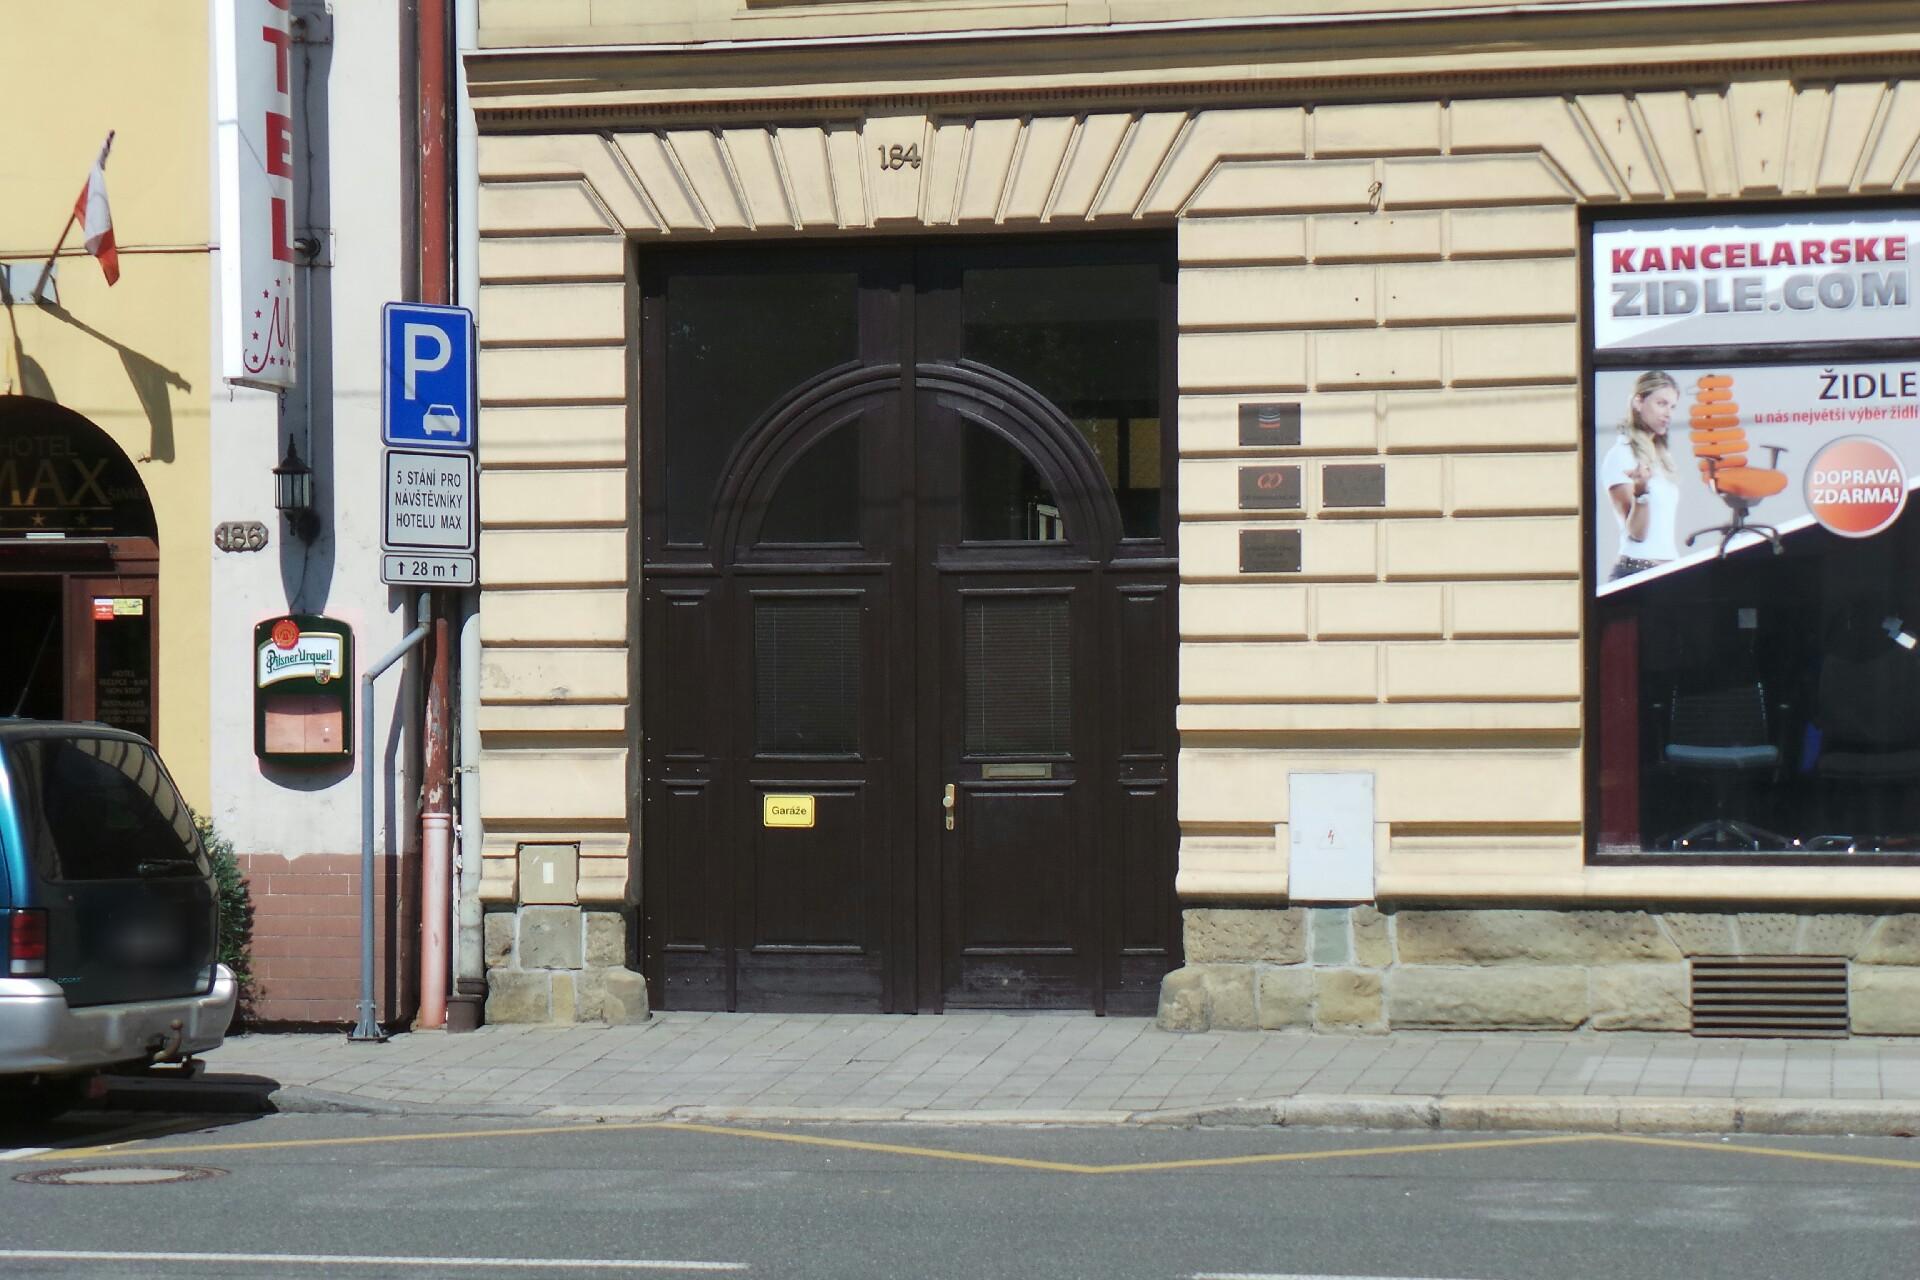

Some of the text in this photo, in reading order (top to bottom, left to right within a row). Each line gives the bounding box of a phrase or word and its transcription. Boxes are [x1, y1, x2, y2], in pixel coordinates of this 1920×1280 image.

[262, 0, 294, 264] TEL
[878, 142, 921, 170] 184
[1611, 235, 1907, 274] KANCELARSKE
[1611, 270, 1908, 318] ZIDLE.COM
[404, 322, 452, 400] P
[1819, 368, 1917, 400] ŽIDLE
[1754, 413, 1763, 424] u
[1766, 409, 1789, 424] nás
[1850, 406, 1888, 424] výběr
[396, 468, 461, 488] 5 STÁNÍ PRO
[1813, 469, 1900, 485] DOPRAVA
[395, 488, 463, 509] NÁVŠTĚVNÍKY
[1813, 487, 1899, 504] ZDARMA!
[396, 513, 462, 530] HOTELU MAX
[412, 561, 445, 577] 28 m
[266, 648, 332, 674] Pilsner Urquell
[771, 805, 807, 815] Garáže
